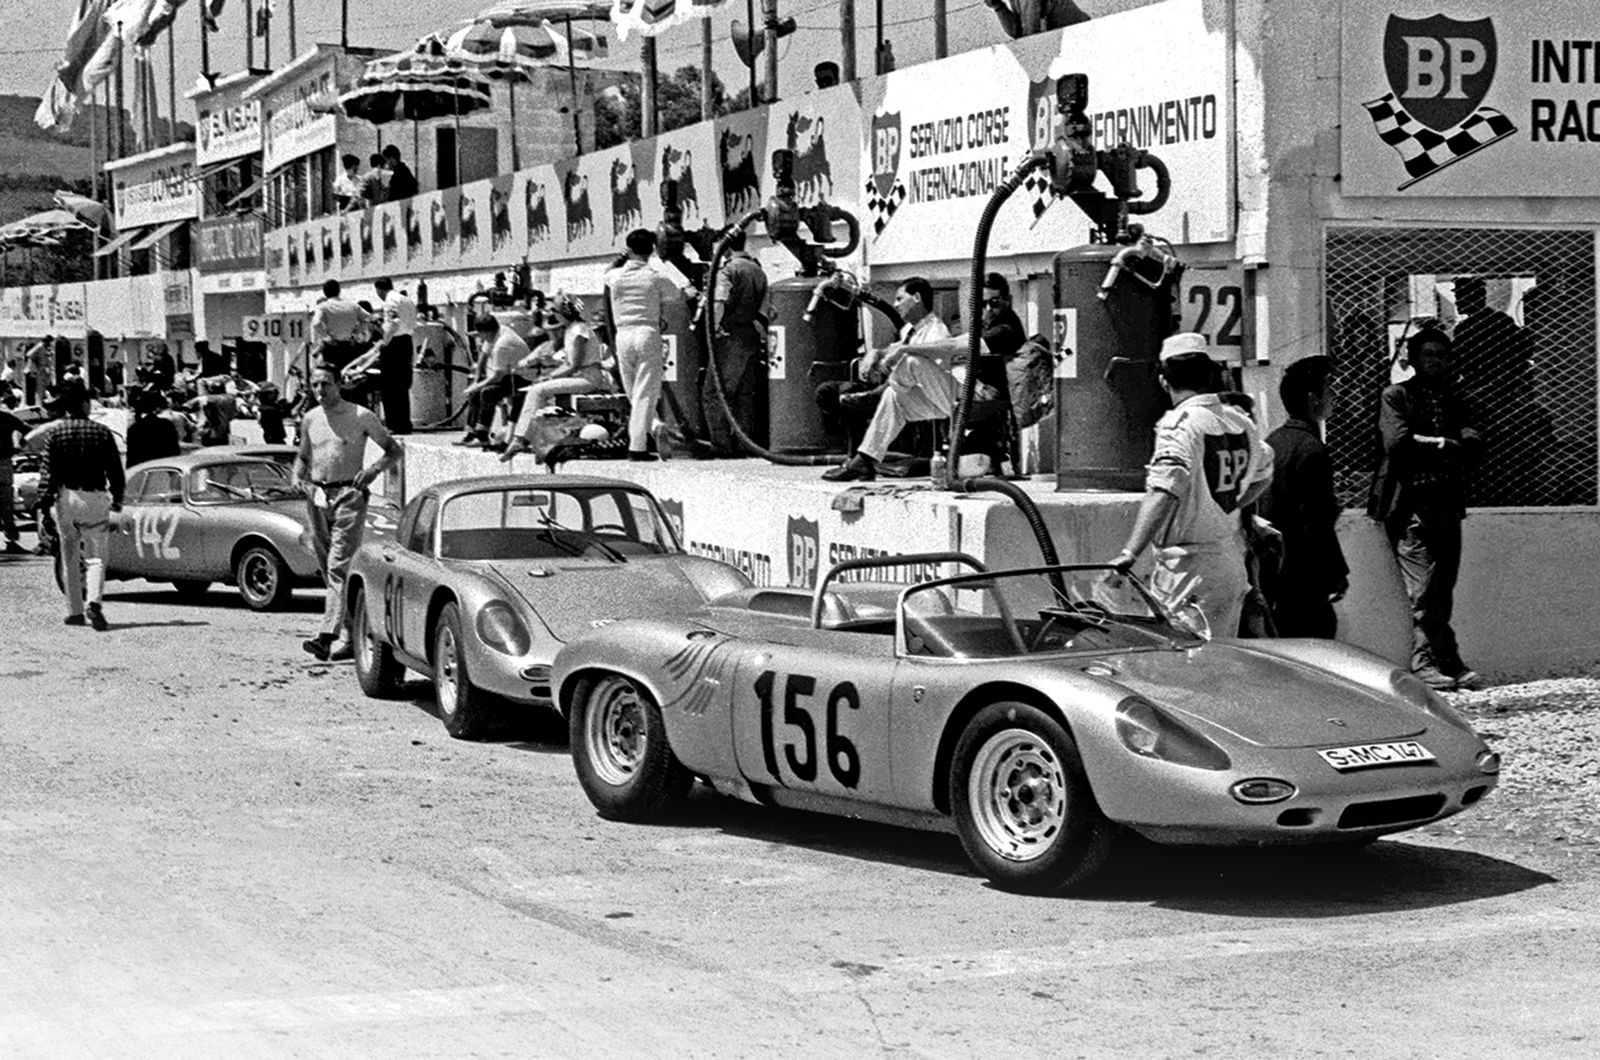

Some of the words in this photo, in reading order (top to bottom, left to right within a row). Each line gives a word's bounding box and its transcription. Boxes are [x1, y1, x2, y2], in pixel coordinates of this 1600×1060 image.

[1400, 36, 1487, 99] BP
[909, 116, 963, 159] SERVIZIO
[967, 106, 1009, 149] CORSE
[1090, 94, 1216, 150] IFORNIMENTO
[876, 127, 899, 175] BP
[247, 319, 259, 337] 9
[264, 319, 281, 337] 10
[289, 319, 303, 338] 11
[1188, 285, 1242, 346] 22
[109, 344, 119, 359] 7
[1215, 449, 1249, 493] BP
[132, 510, 181, 560] 142
[791, 533, 817, 588] BP
[754, 670, 861, 790] 156
[1387, 742, 1424, 759] 147
